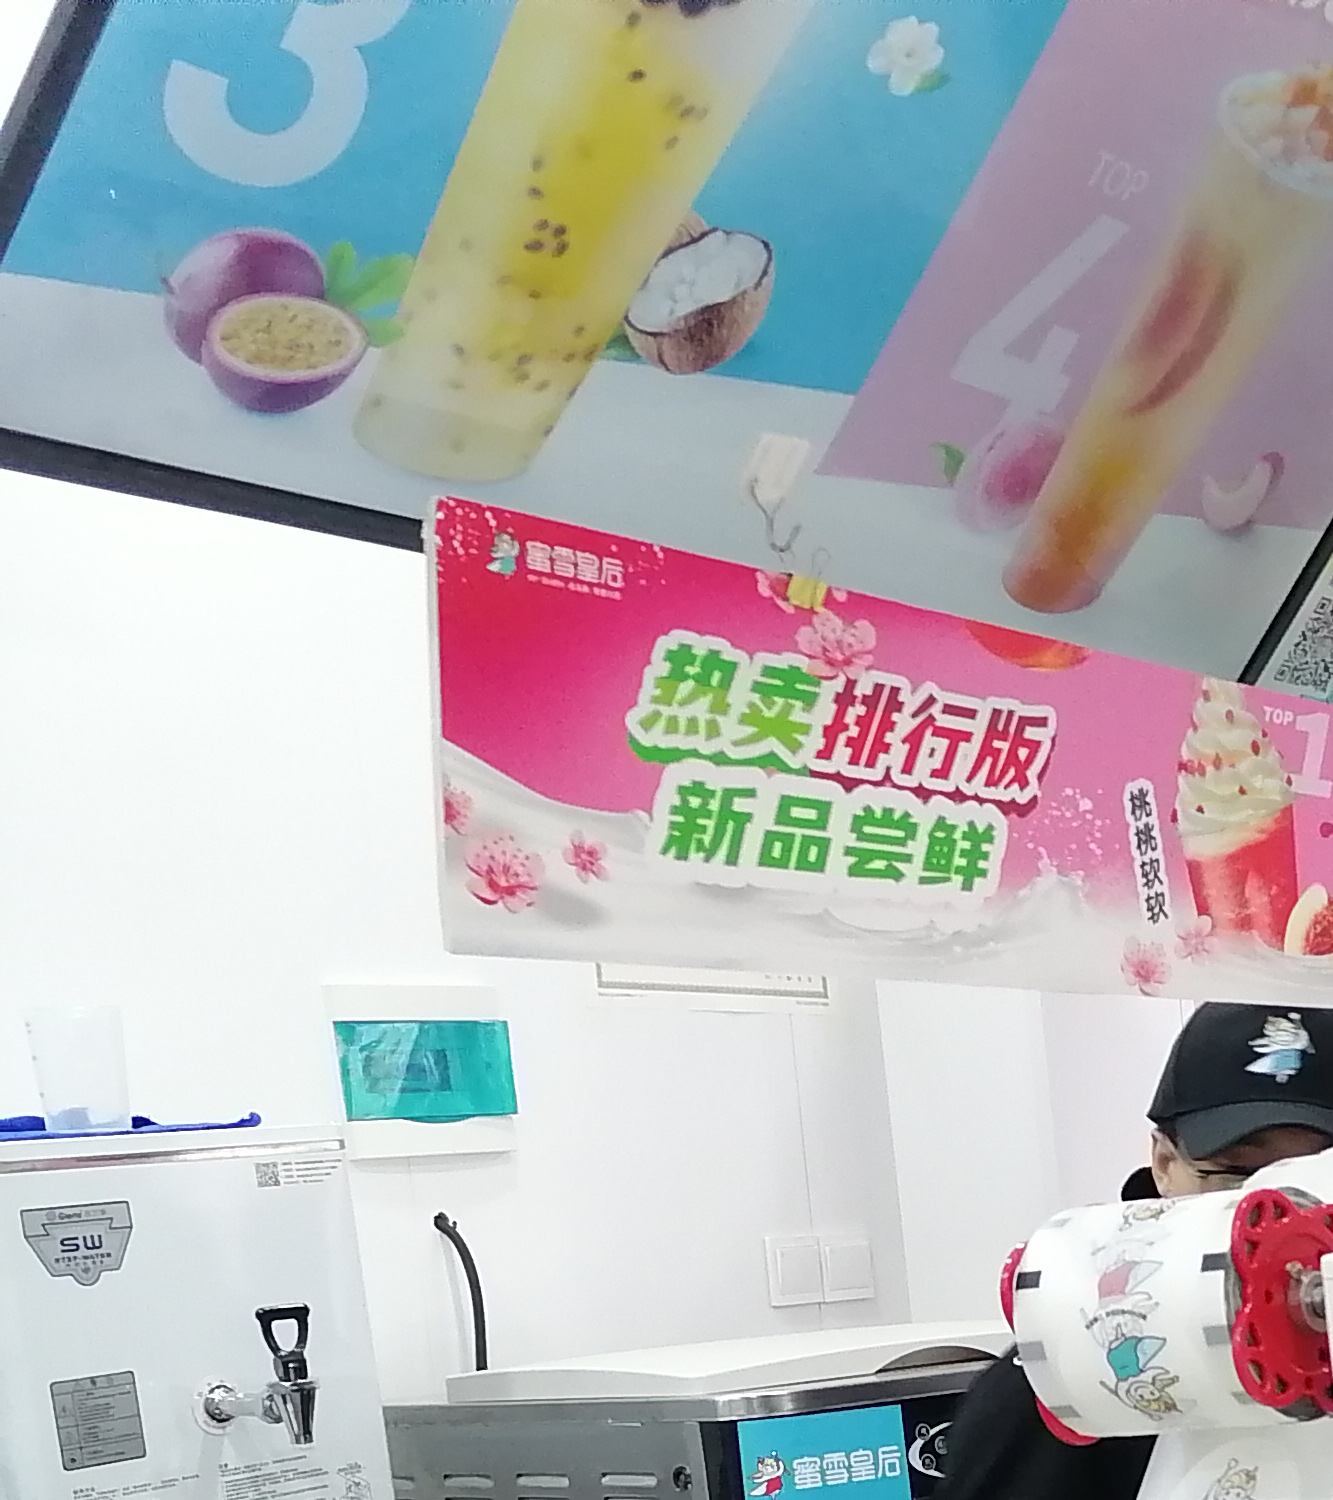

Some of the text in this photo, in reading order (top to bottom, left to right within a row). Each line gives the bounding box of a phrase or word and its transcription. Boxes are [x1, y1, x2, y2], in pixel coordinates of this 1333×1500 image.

[1091, 152, 1150, 199] TOP
[950, 213, 1131, 424] 4
[525, 540, 625, 588] 蜜雪皇后
[634, 640, 1050, 795] 热卖排行版
[1263, 705, 1333, 798] TOP 1
[659, 780, 996, 892] 新品尝鲜
[1129, 787, 1169, 925] 桃桃软软
[59, 1234, 103, 1253] SW
[792, 1445, 901, 1490] 蜜雪皇后
